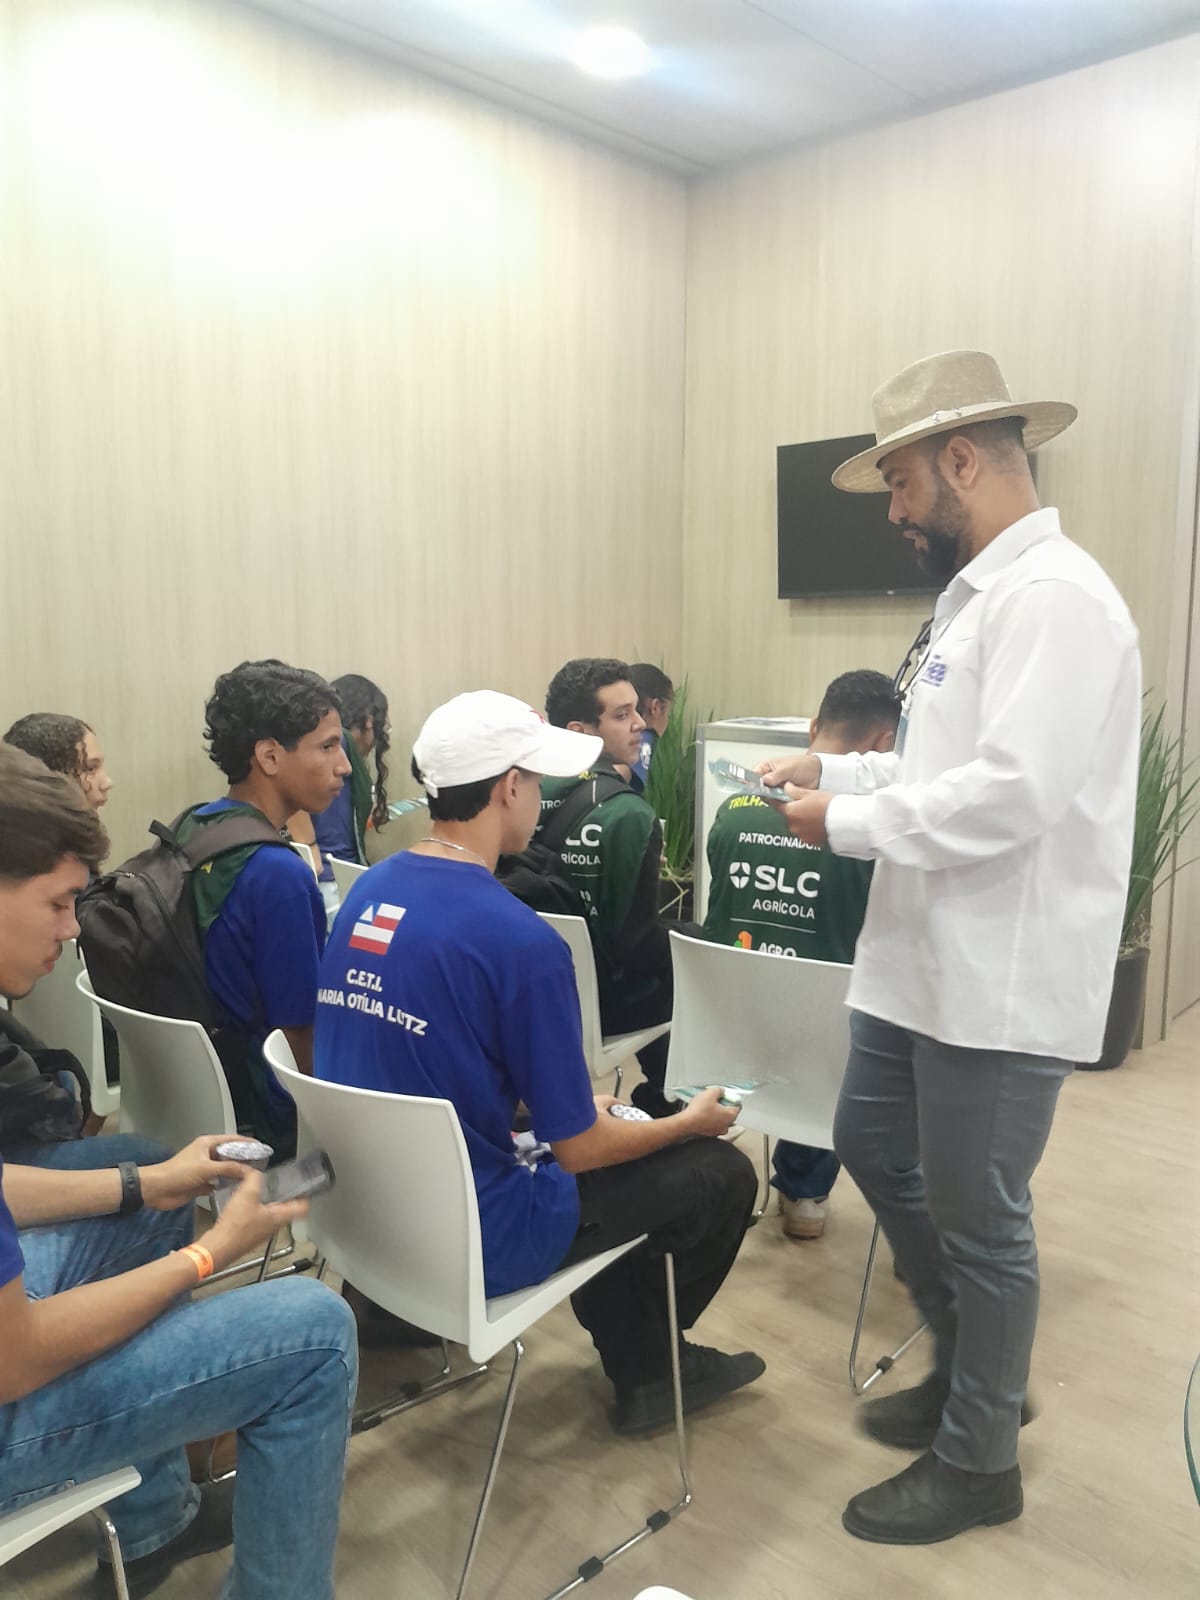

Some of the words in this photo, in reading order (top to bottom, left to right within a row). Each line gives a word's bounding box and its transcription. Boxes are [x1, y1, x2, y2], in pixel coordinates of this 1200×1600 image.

[739, 832, 821, 851] PATROCINAD
[560, 852, 602, 865] RÍCOLA
[755, 864, 821, 898] SLC
[752, 898, 815, 919] AGRÍCOLA
[758, 942, 797, 957] AGRO
[347, 992, 384, 1018] OTÍLIA
[387, 1005, 428, 1036] LUTZ
